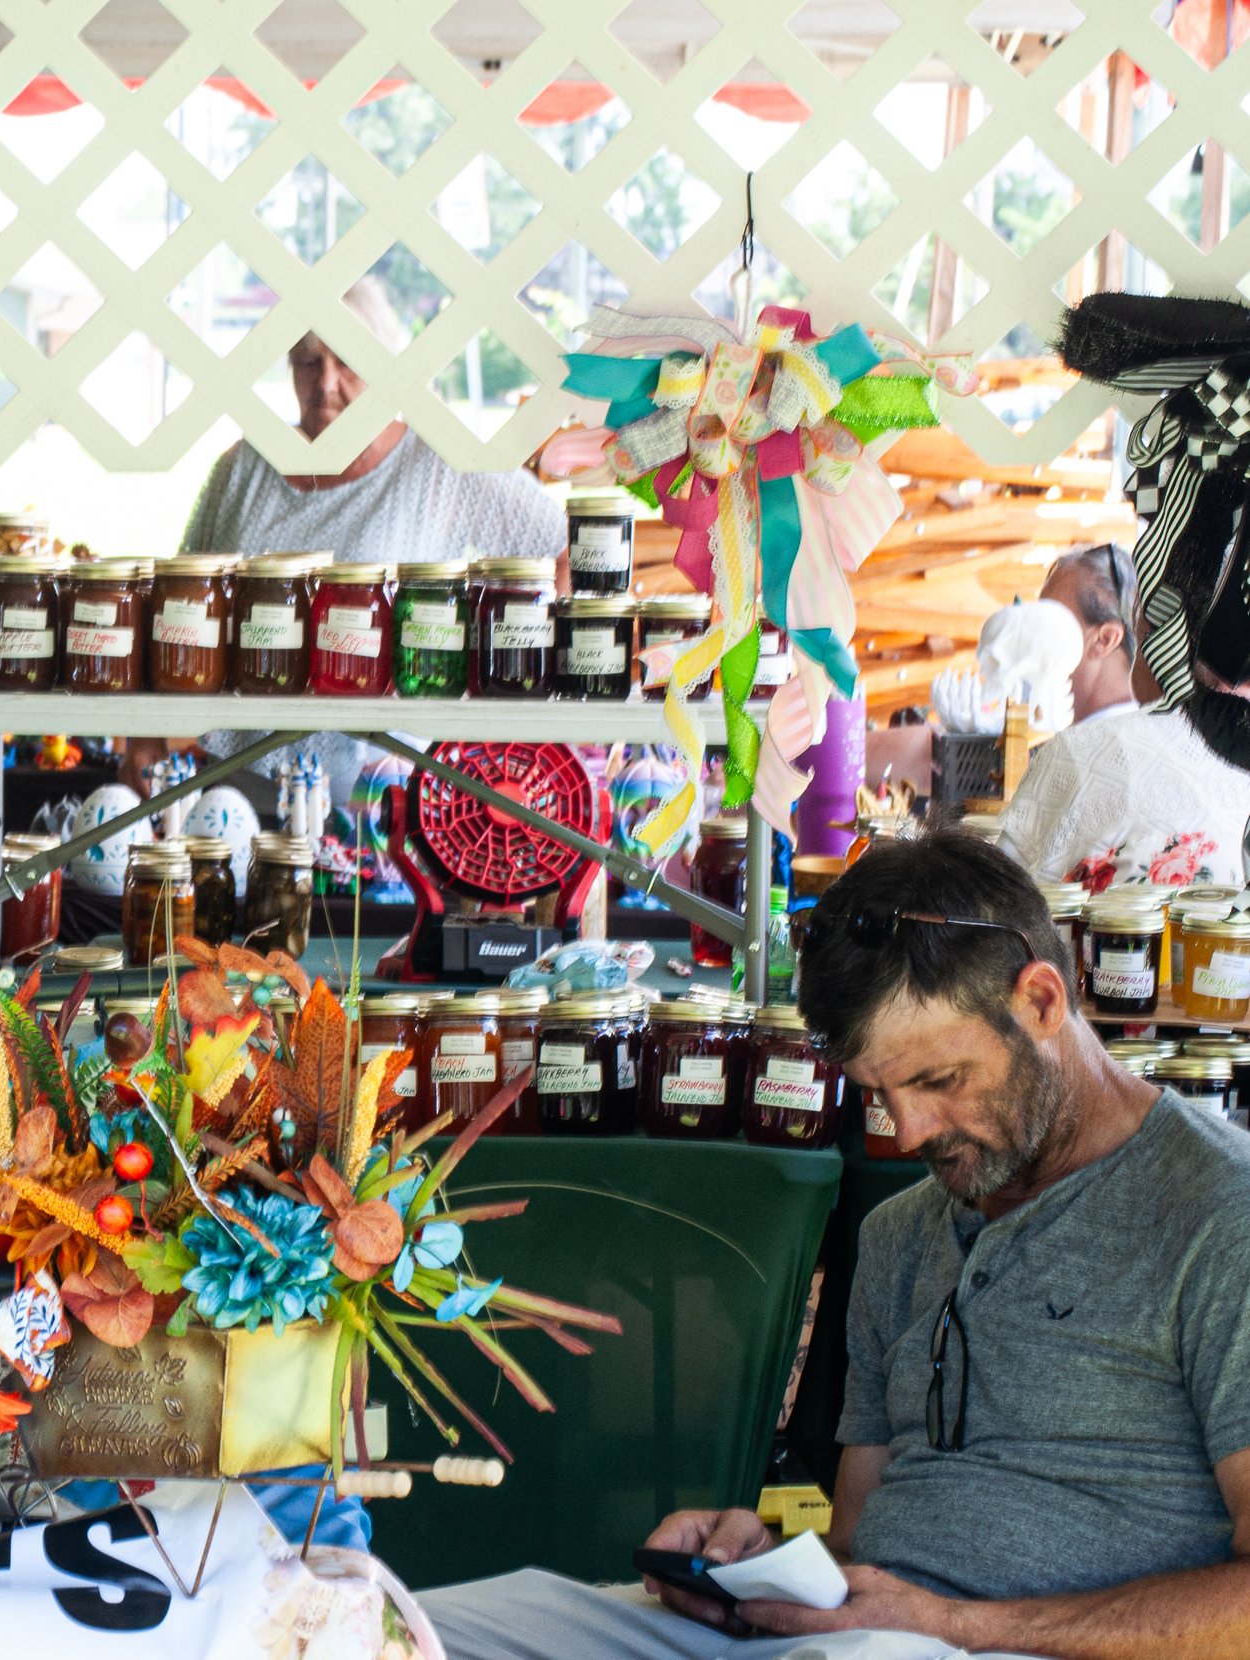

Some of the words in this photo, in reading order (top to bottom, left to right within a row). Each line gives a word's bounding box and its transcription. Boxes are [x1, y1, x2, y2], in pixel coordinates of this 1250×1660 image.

[156, 620, 198, 637] PUMPKIN
[320, 628, 339, 641] RED
[493, 623, 552, 634] BLACKBERRY
[0, 631, 34, 643] APPLE
[248, 636, 274, 648] JAM
[413, 632, 449, 649] JELLY
[502, 636, 535, 648] JELLY
[72, 642, 103, 654] BUTTER
[478, 940, 527, 956] Bauer
[433, 1056, 466, 1069] PEACH
[473, 1067, 495, 1078] JAM
[399, 1087, 416, 1096] JAM
[666, 1079, 724, 1092] STRAWBERRY
[757, 1079, 818, 1099] RASPBERRY
[873, 1121, 895, 1136] JA
